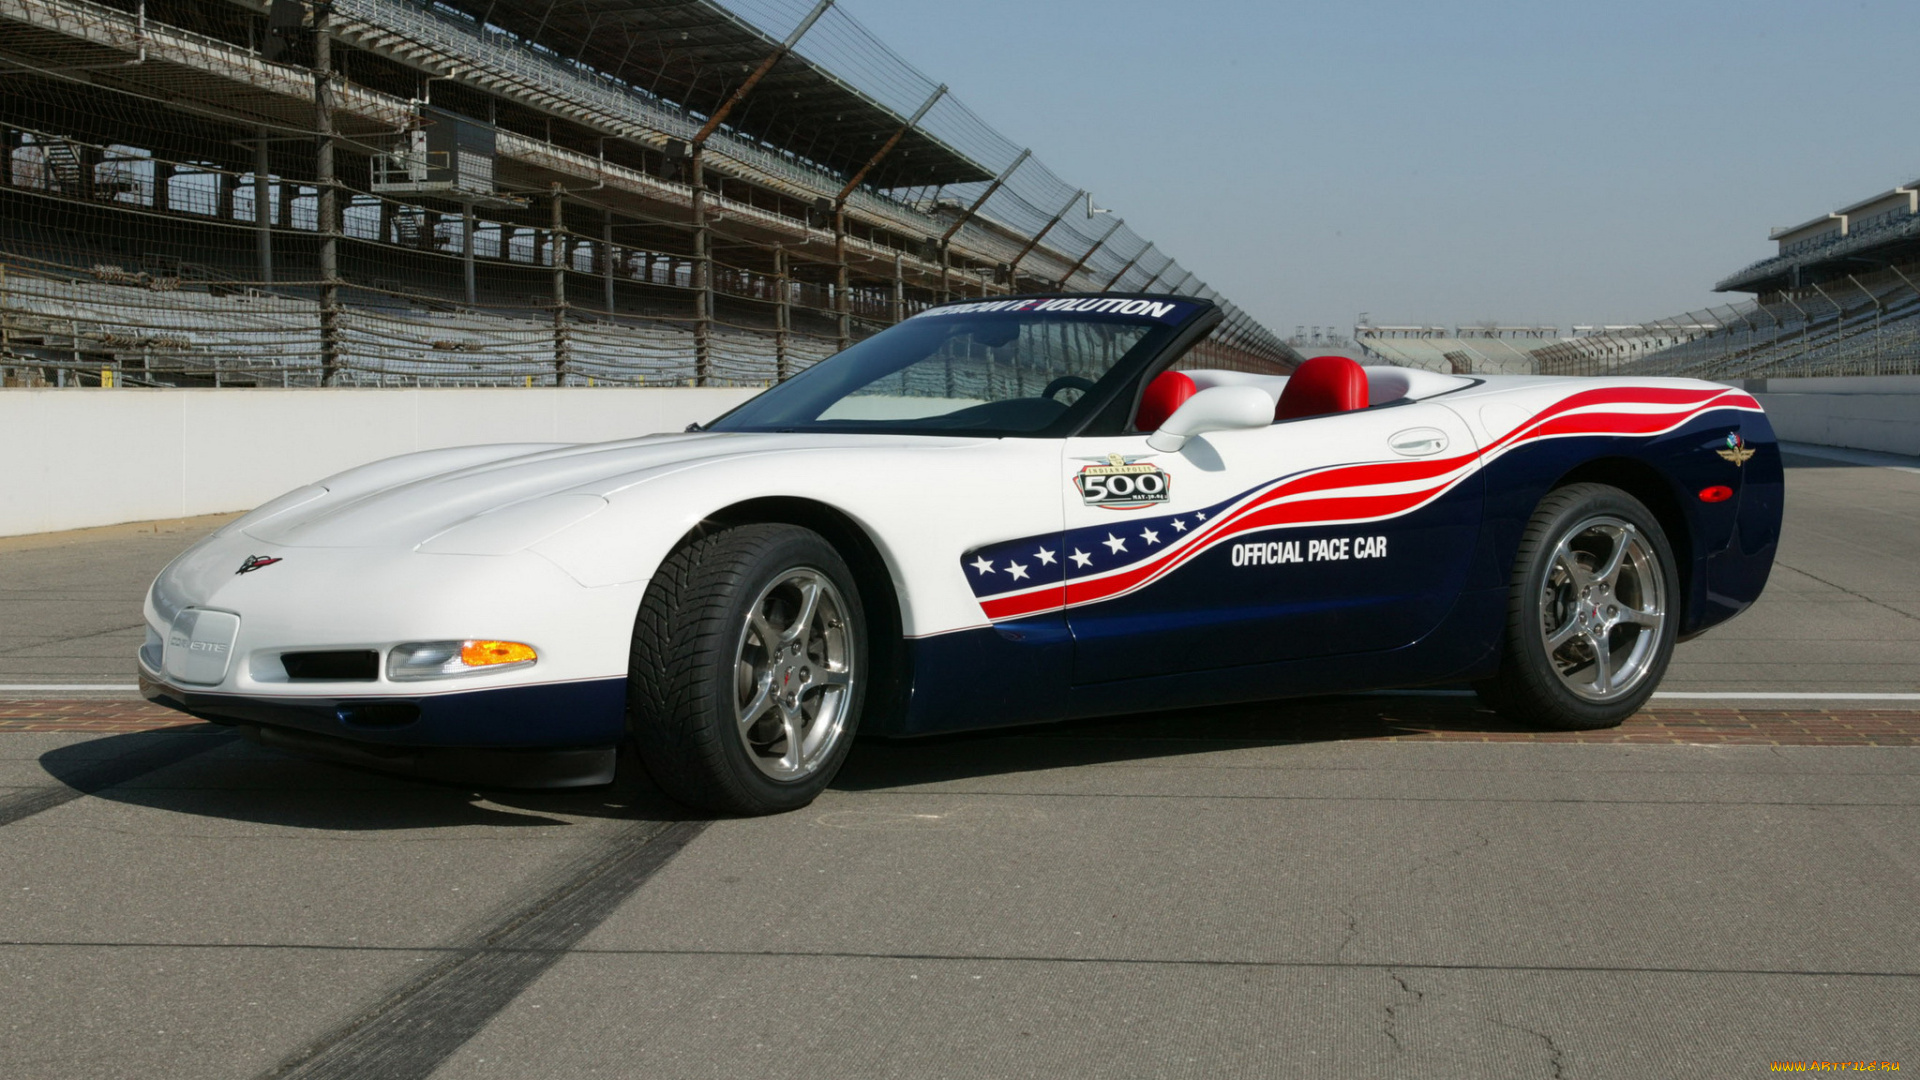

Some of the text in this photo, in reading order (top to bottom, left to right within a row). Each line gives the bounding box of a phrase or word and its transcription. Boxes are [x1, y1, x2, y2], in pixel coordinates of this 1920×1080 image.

[1088, 466, 1152, 475] INDIANAPOLIS
[1084, 474, 1164, 502] 500
[1231, 536, 1388, 567] OFFICIAL PACE CAR
